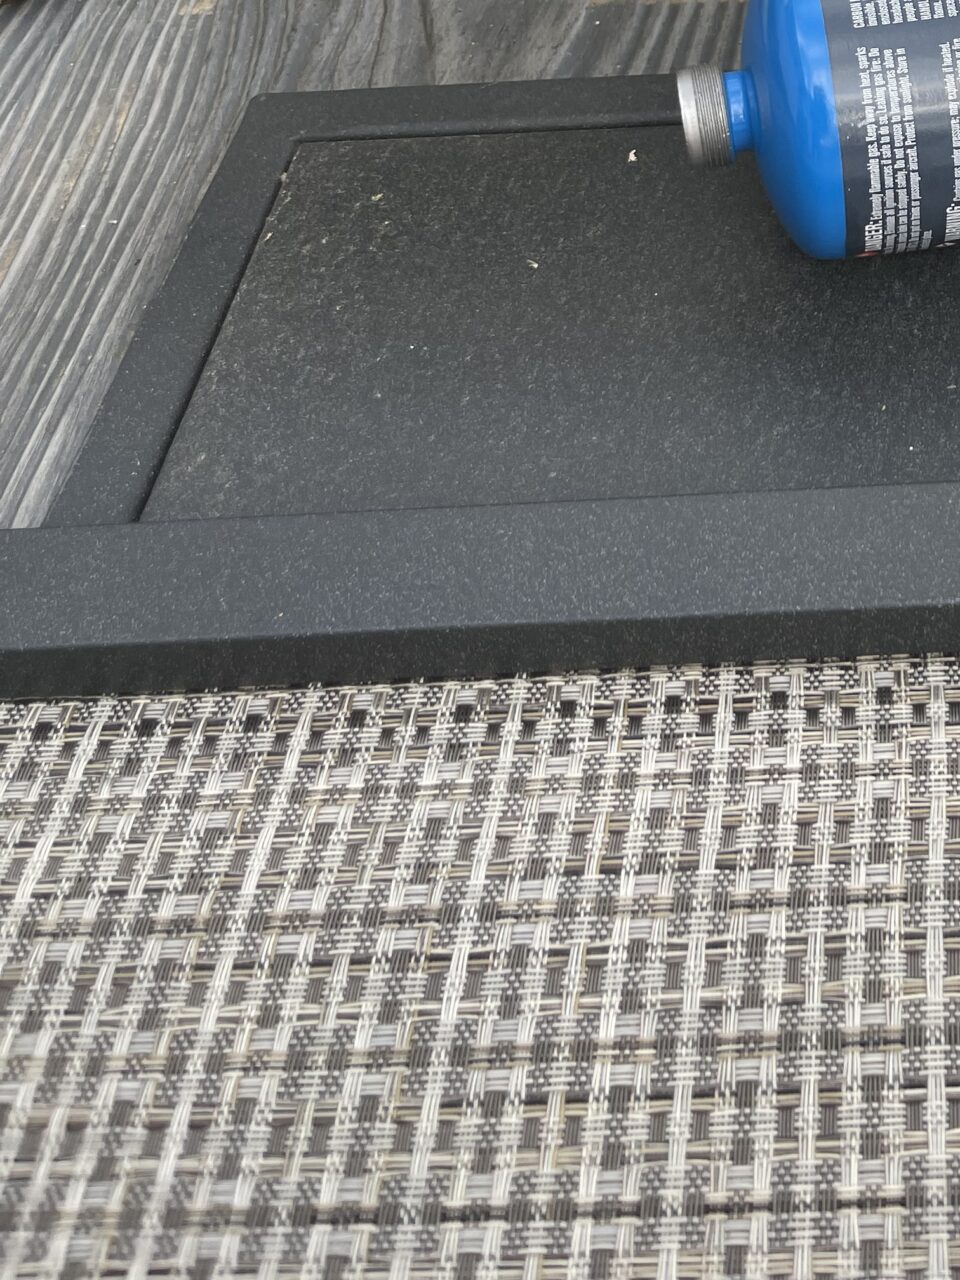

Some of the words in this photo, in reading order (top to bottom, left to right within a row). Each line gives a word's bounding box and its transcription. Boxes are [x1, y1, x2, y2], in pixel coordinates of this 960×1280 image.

[849, 2, 866, 28] CARBON
[876, 0, 890, 25] enclosed
[903, 3, 918, 22] people
[854, 47, 870, 70] sparks
[868, 48, 880, 57] Do
[882, 49, 894, 68] above
[938, 42, 952, 66] heated.
[874, 74, 886, 86] gas
[944, 74, 958, 100] explode
[874, 87, 888, 114] Leaking
[902, 104, 914, 120] from
[865, 124, 878, 142] Keep
[878, 126, 890, 134] do
[892, 124, 904, 146] expose
[880, 136, 890, 144] to
